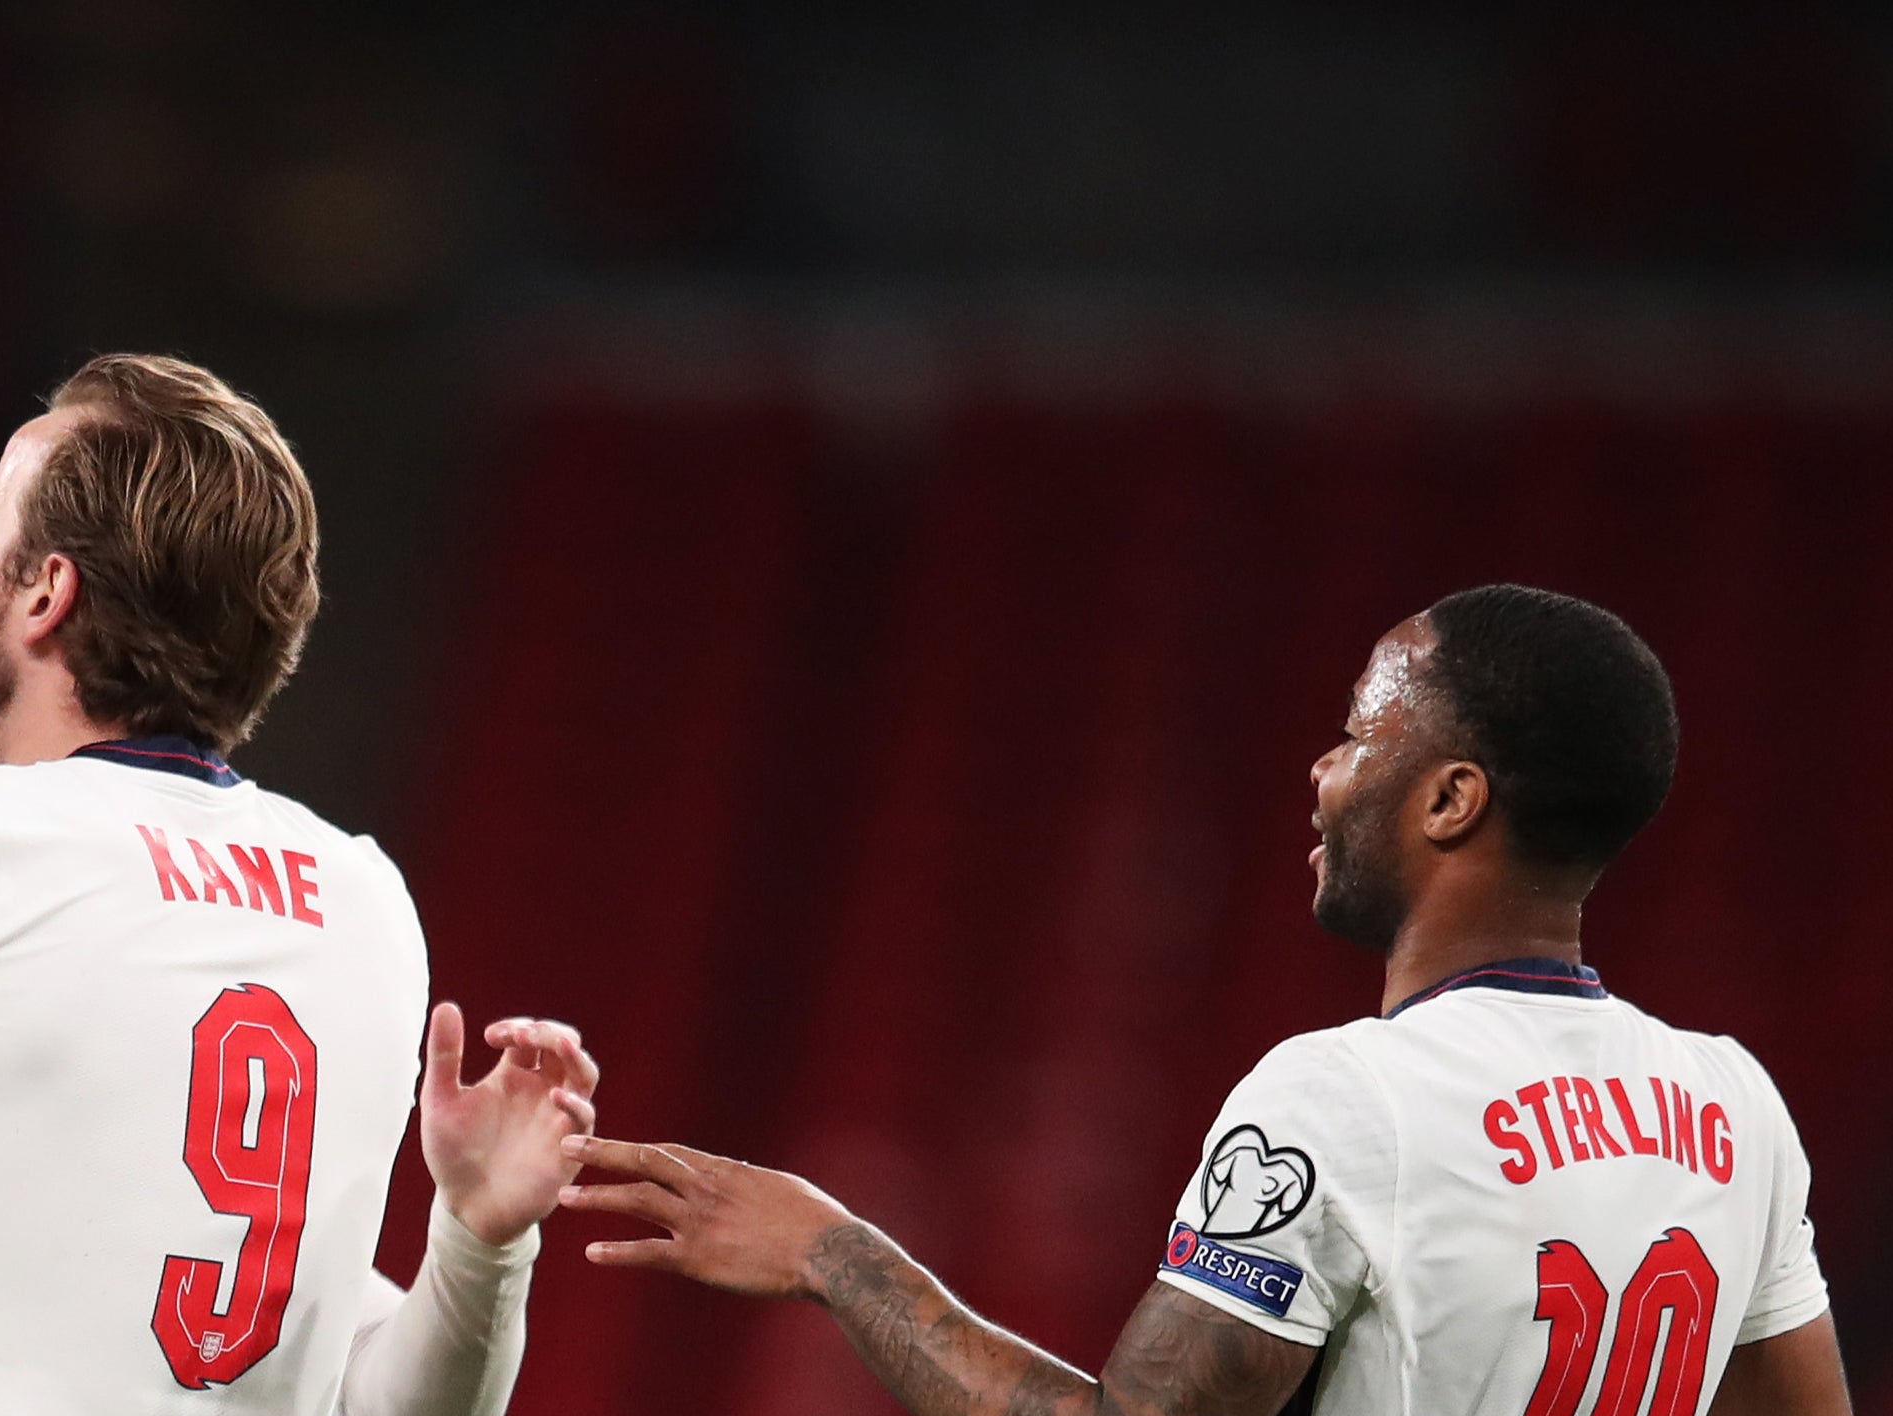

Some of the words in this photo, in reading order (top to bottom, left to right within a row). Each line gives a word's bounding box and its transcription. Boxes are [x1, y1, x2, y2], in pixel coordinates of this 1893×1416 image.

[135, 825, 324, 928] KANE
[1483, 1075, 1734, 1185] STERLING
[150, 982, 318, 1390] 9
[1192, 1244, 1296, 1303] RESPECT
